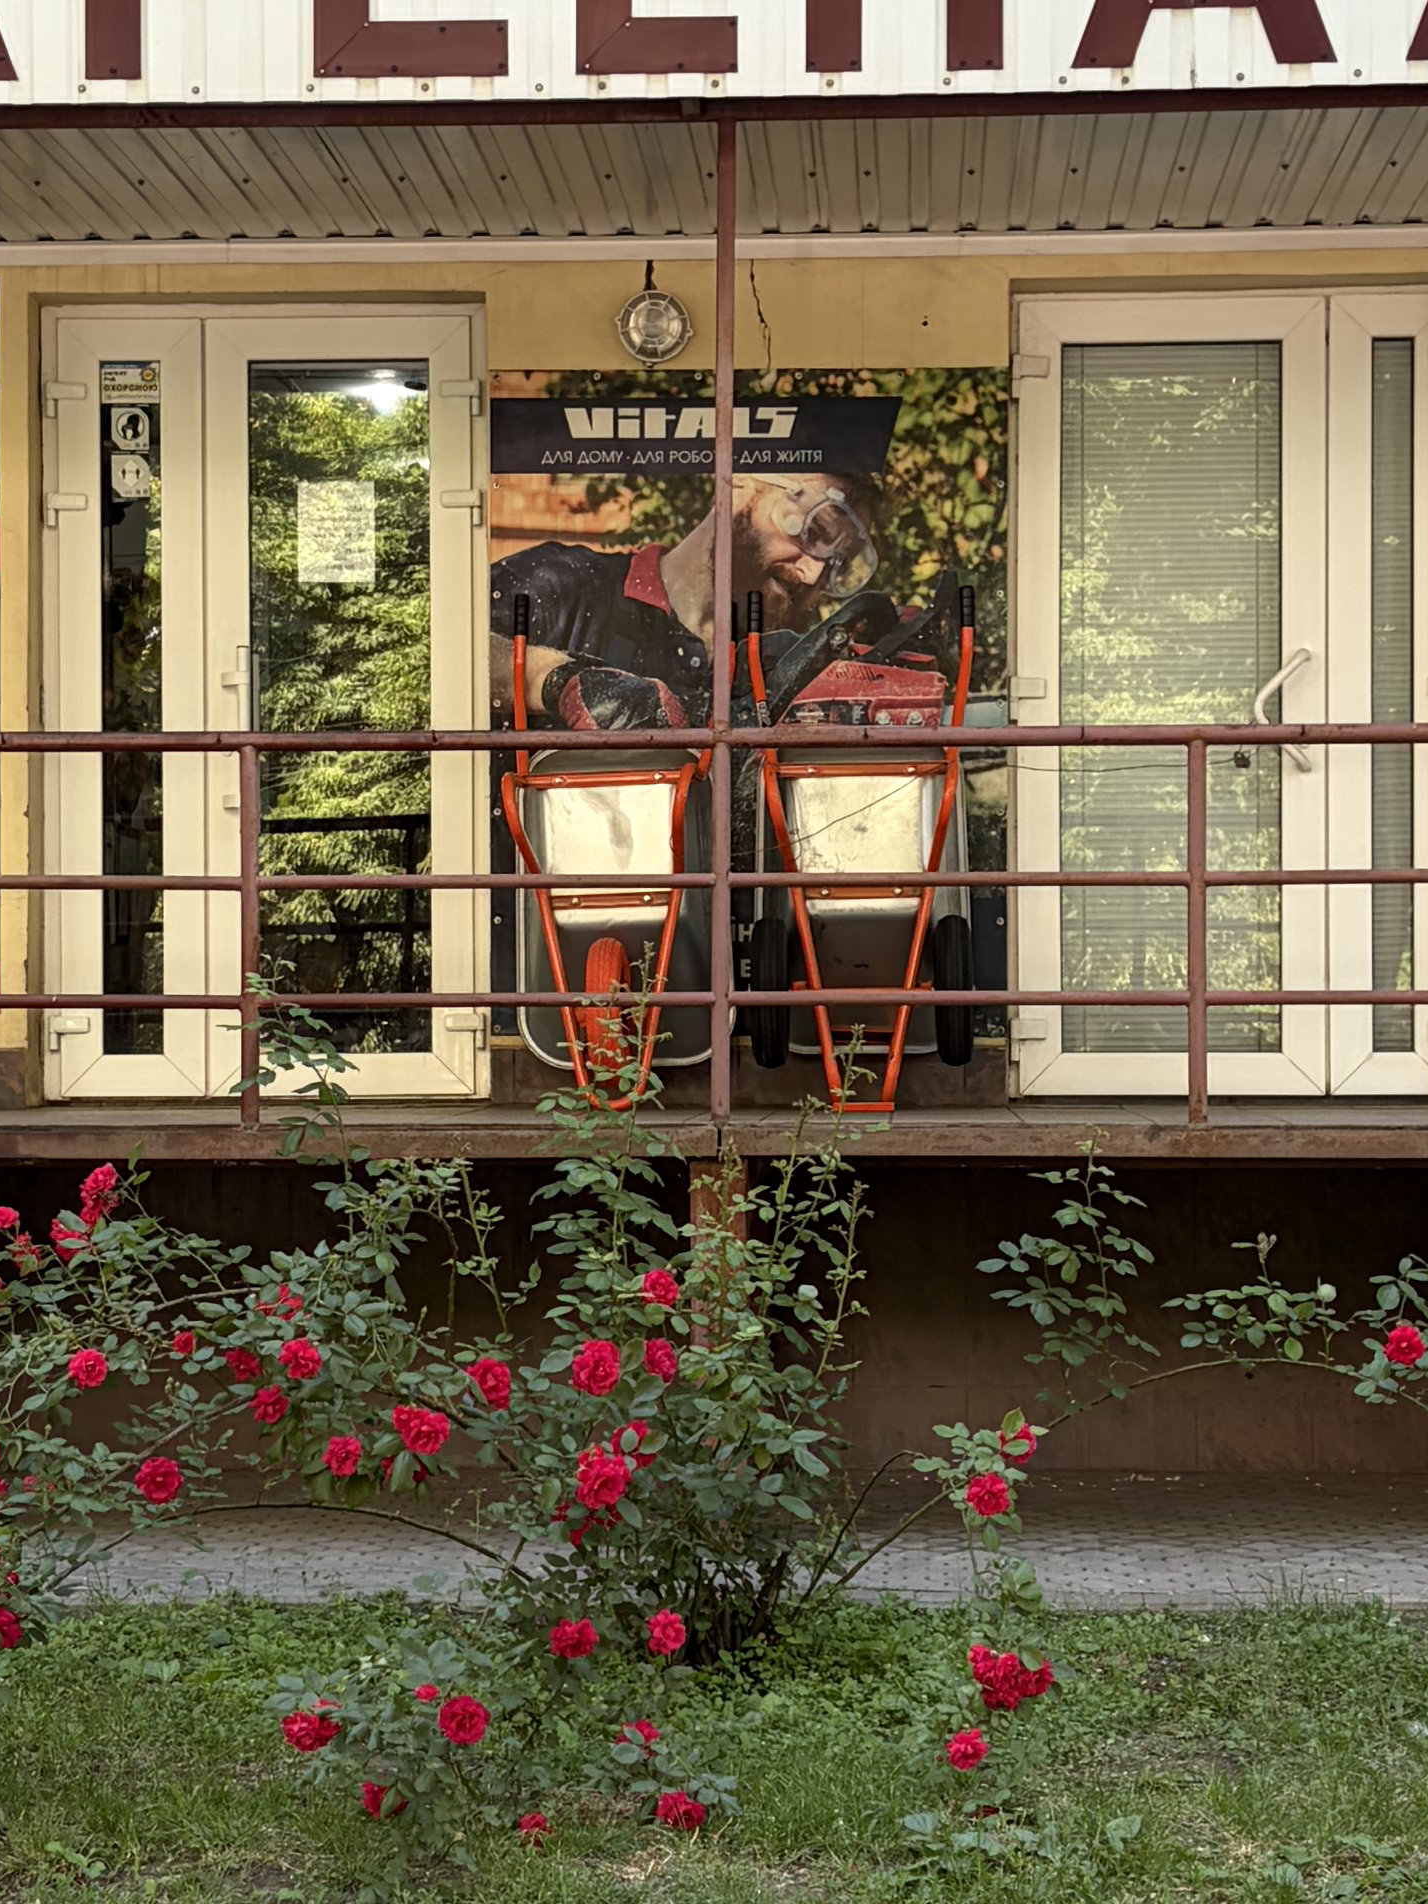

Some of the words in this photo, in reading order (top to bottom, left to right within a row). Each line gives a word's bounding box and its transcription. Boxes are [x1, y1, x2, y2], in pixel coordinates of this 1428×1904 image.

[541, 450, 573, 465] ДЛЯ
[577, 450, 624, 465] ДОМУ
[632, 450, 664, 465] ДЛЯ
[669, 450, 717, 464] РОБО
[739, 449, 772, 464] ДЛЯ
[776, 449, 822, 463] ЖИТТЯ
